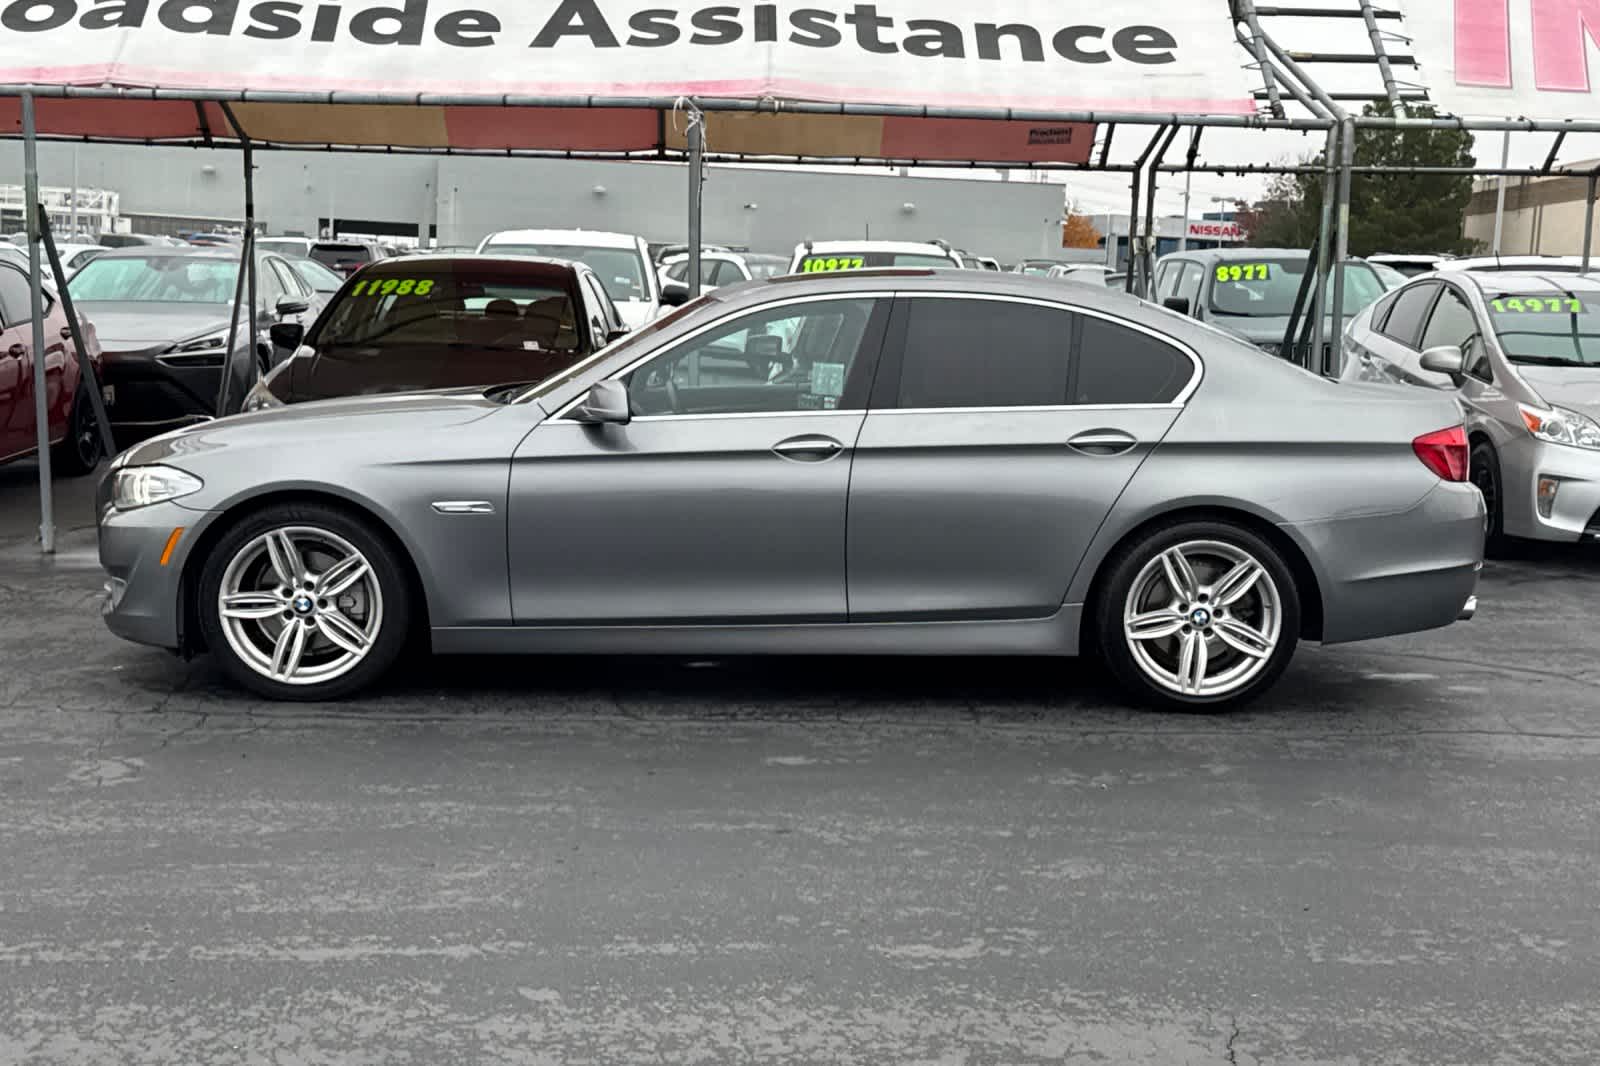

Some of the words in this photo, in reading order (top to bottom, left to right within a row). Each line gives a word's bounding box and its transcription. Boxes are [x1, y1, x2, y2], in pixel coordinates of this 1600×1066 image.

[529, 0, 1179, 64] Assistance
[1190, 224, 1241, 236] NISSAN
[803, 259, 863, 272] 10977
[1216, 264, 1268, 282] 8977
[352, 279, 434, 296] 11988
[1491, 299, 1580, 312] 14977
